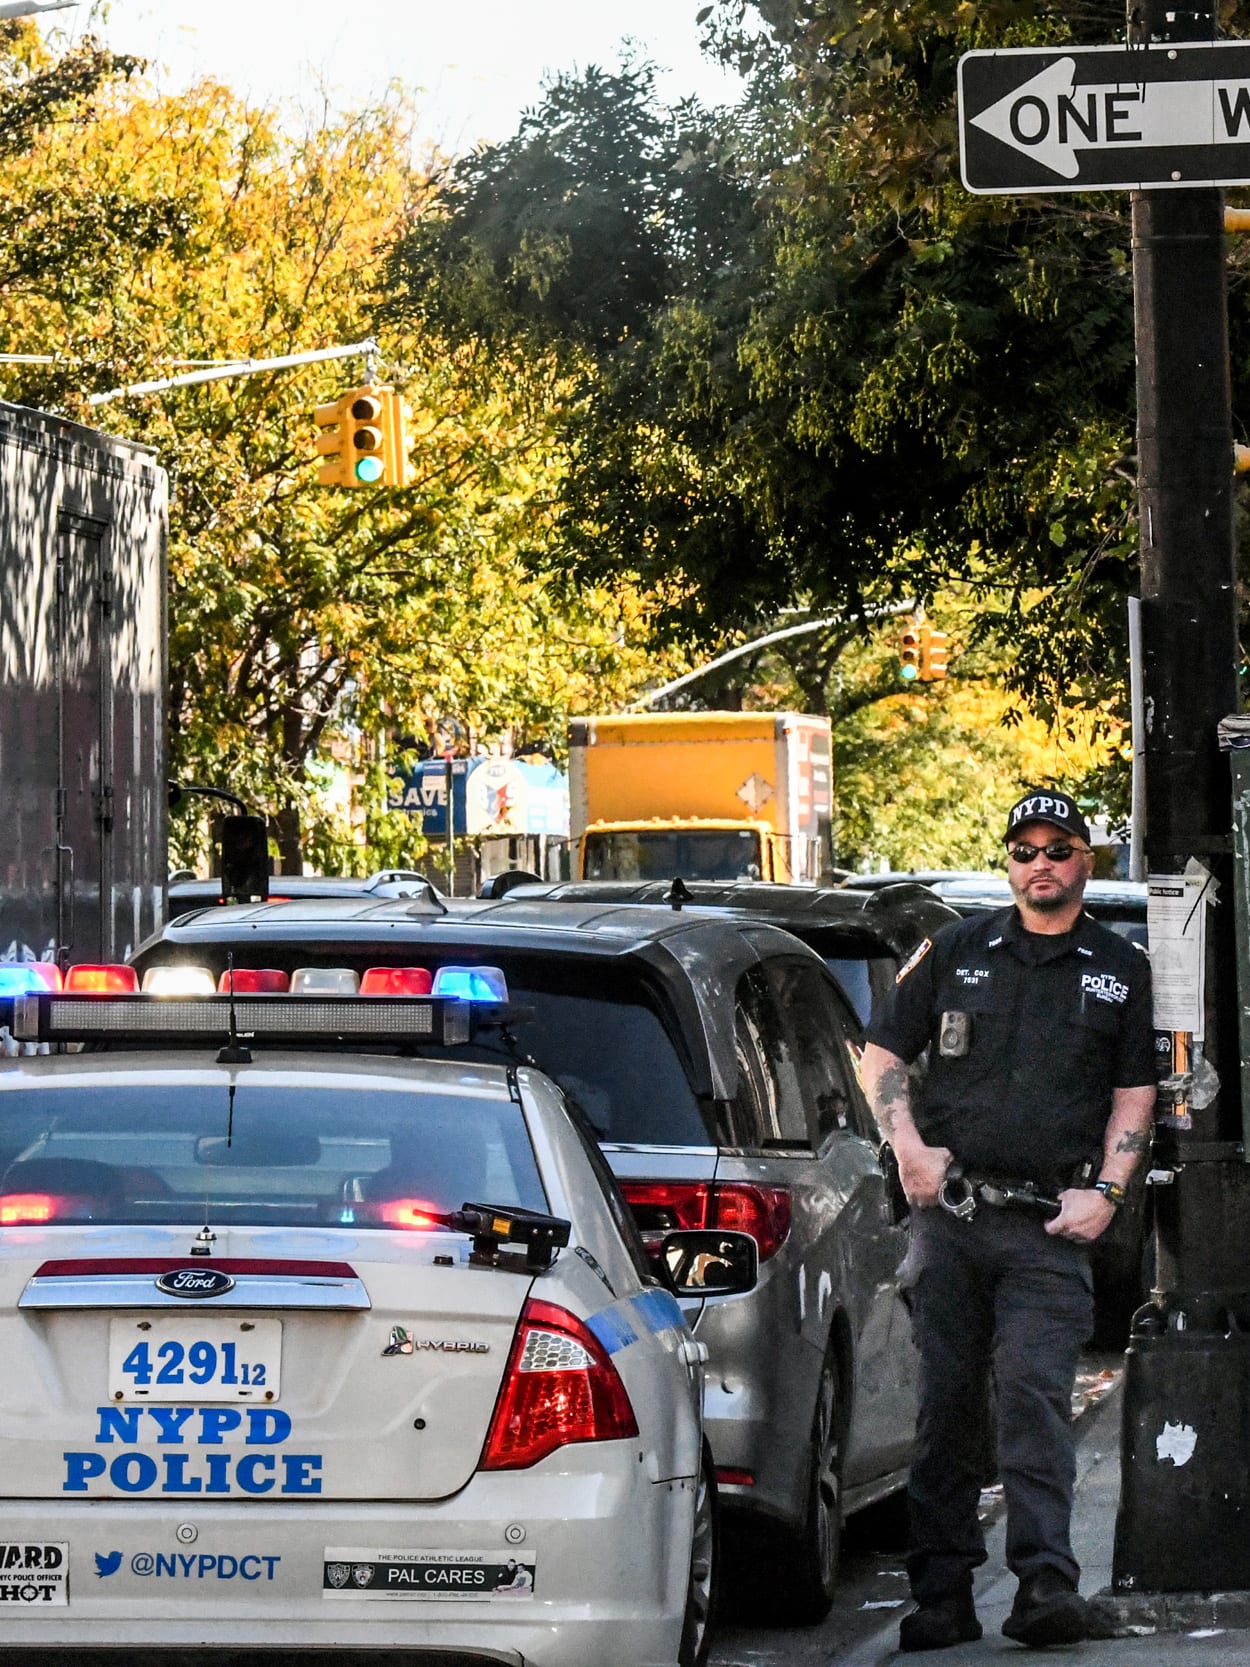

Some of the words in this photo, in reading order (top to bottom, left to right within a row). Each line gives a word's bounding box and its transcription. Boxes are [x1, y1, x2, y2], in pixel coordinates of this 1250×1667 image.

[1009, 92, 1143, 146] ONE
[388, 787, 448, 807] SAVE
[1011, 796, 1070, 826] NYPD
[974, 969, 989, 978] COX
[1081, 974, 1130, 1000] POLICE
[173, 1272, 216, 1289] Ford
[415, 1340, 491, 1353] HYBRID
[122, 1340, 238, 1385] 4291
[241, 1363, 266, 1386] 12
[95, 1406, 292, 1445] NYPD
[63, 1452, 323, 1494] POLICE
[0, 1545, 63, 1569] ARD
[131, 1552, 281, 1581] @NYPDCT
[387, 1568, 420, 1583] PAL
[424, 1569, 486, 1584] CARES
